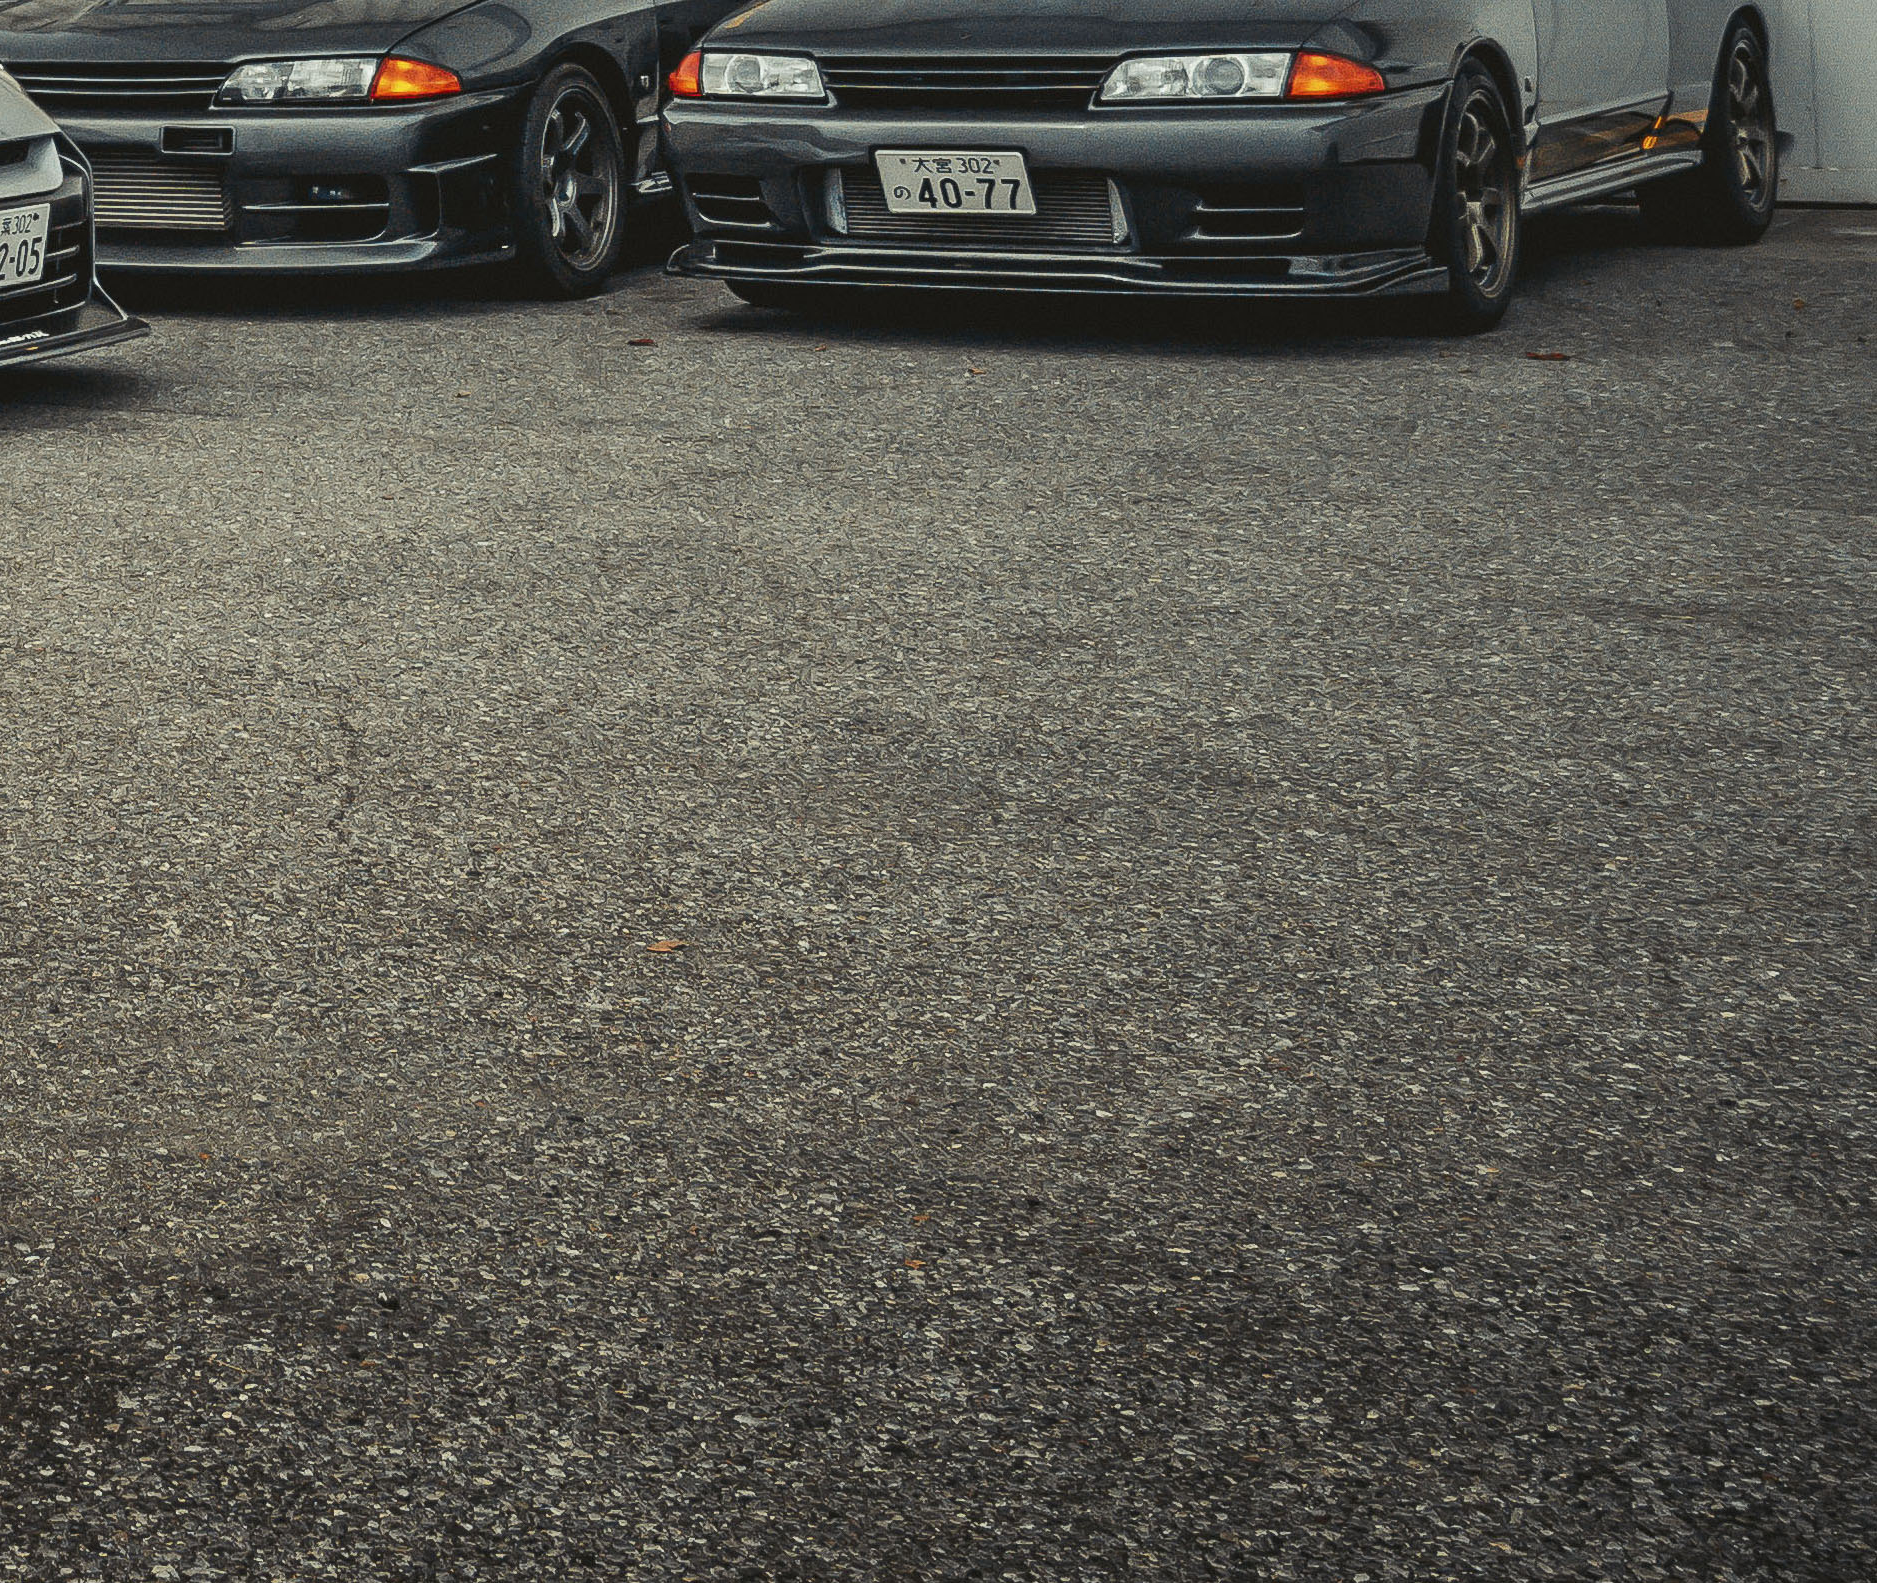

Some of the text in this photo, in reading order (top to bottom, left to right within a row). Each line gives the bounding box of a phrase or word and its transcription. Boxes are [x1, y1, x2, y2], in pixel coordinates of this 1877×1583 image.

[956, 157, 994, 174] 302
[893, 177, 1021, 210] の 40-77
[12, 213, 33, 236] 302
